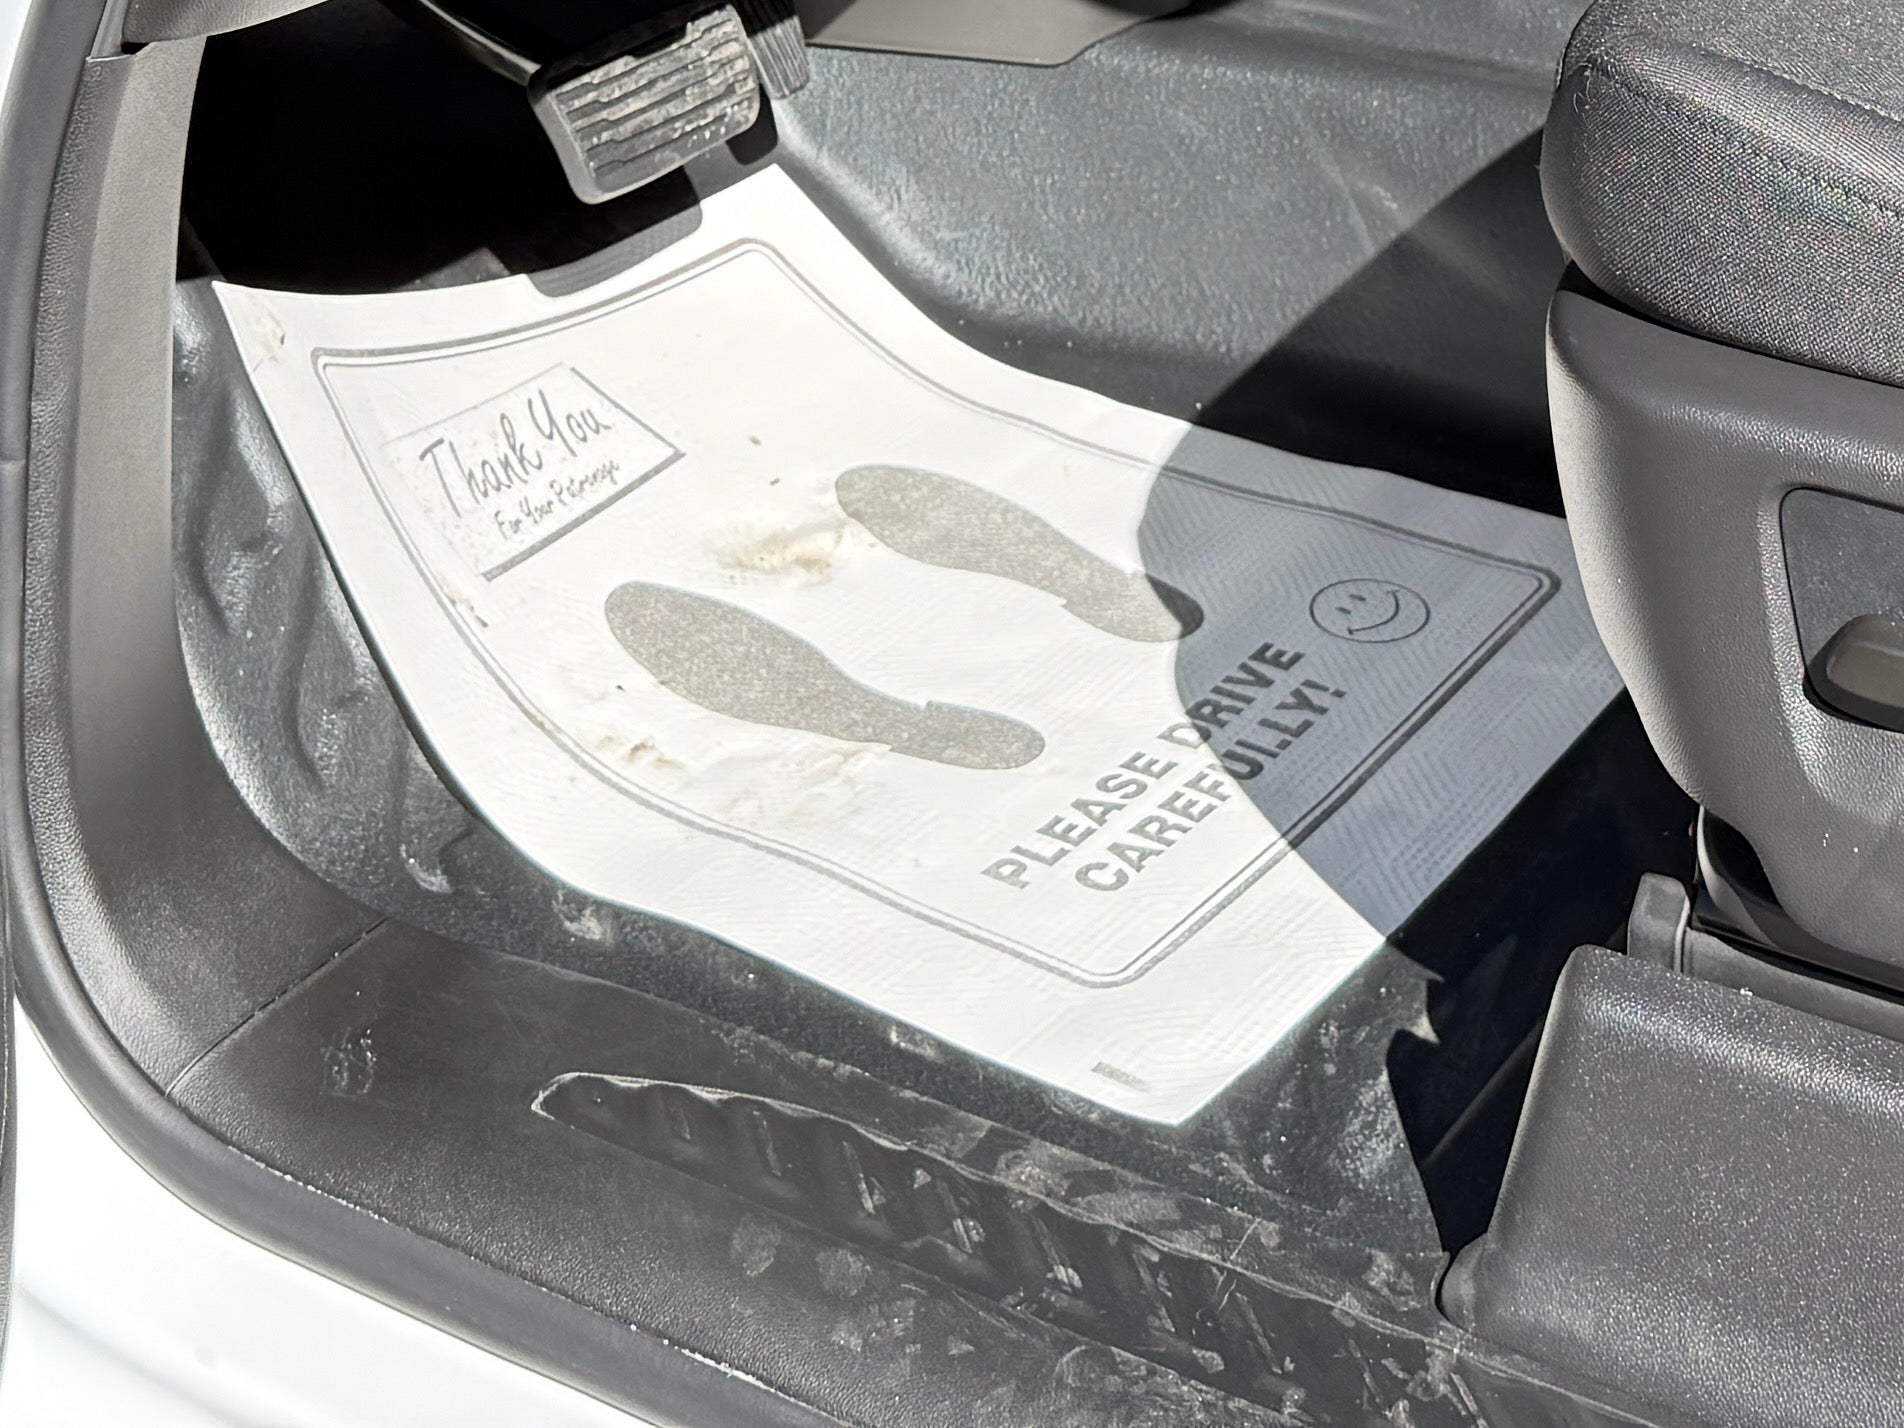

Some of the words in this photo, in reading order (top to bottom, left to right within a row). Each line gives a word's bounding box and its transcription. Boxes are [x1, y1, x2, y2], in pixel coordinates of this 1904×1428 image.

[419, 412, 543, 519] Thank
[527, 389, 612, 457] You
[980, 751, 1179, 890] PLEASE
[1157, 642, 1305, 749] DRIVE
[1075, 679, 1348, 892] CAREFULLY!
